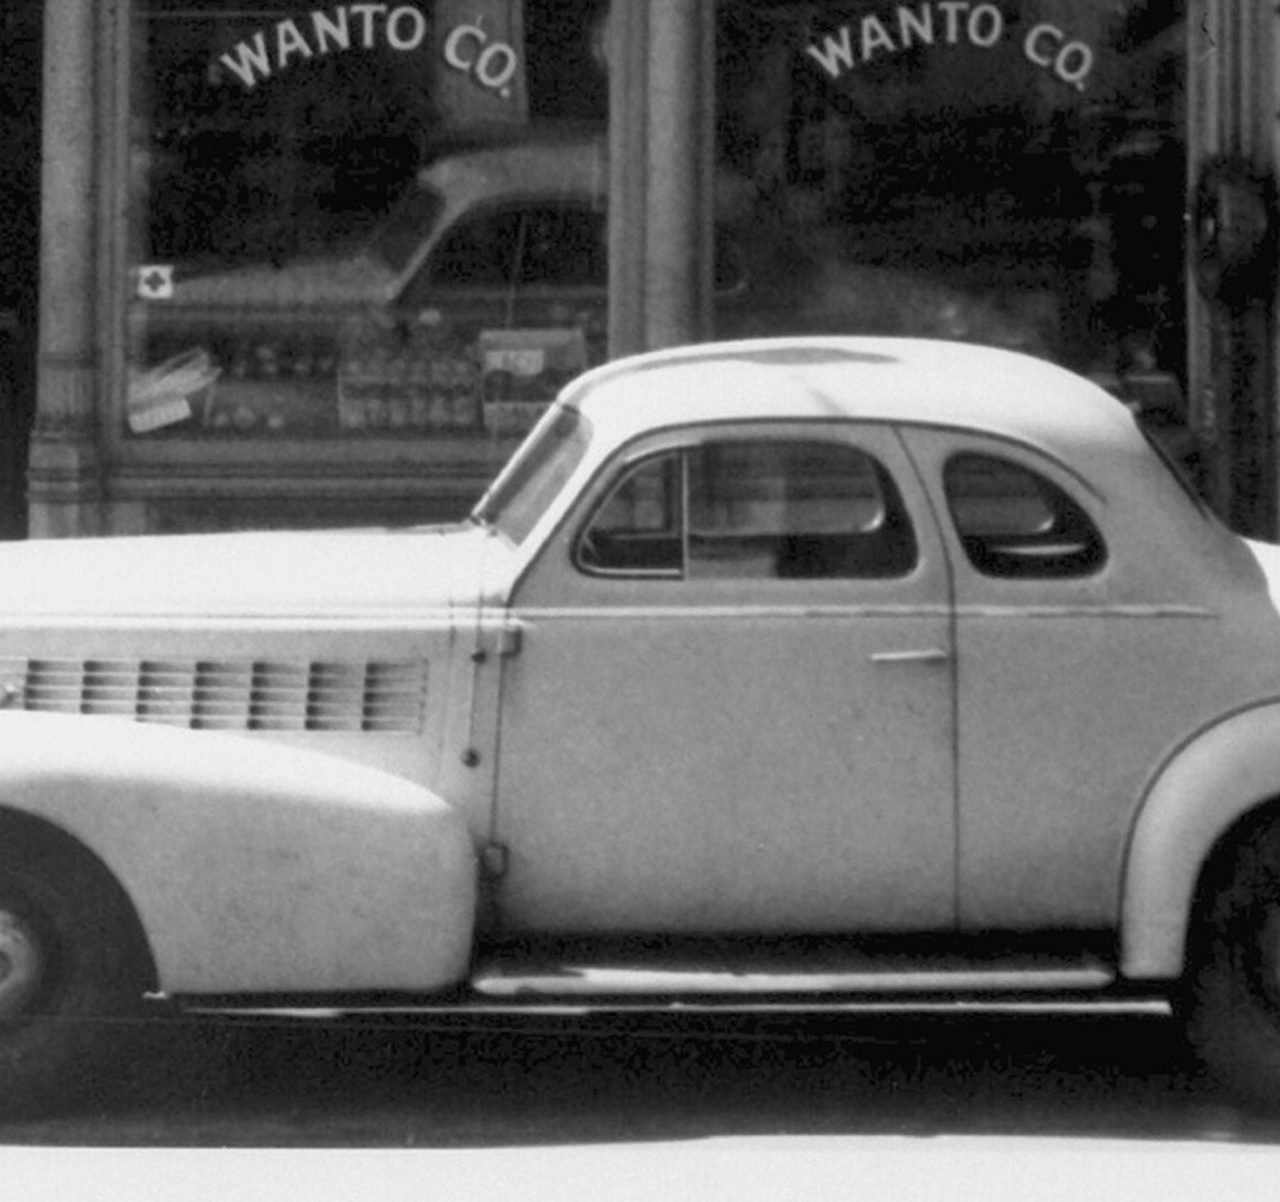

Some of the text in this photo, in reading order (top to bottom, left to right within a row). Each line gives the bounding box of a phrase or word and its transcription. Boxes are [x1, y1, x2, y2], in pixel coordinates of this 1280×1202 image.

[220, 2, 518, 98] WANTO CO.
[806, 0, 1003, 80] WANTO
